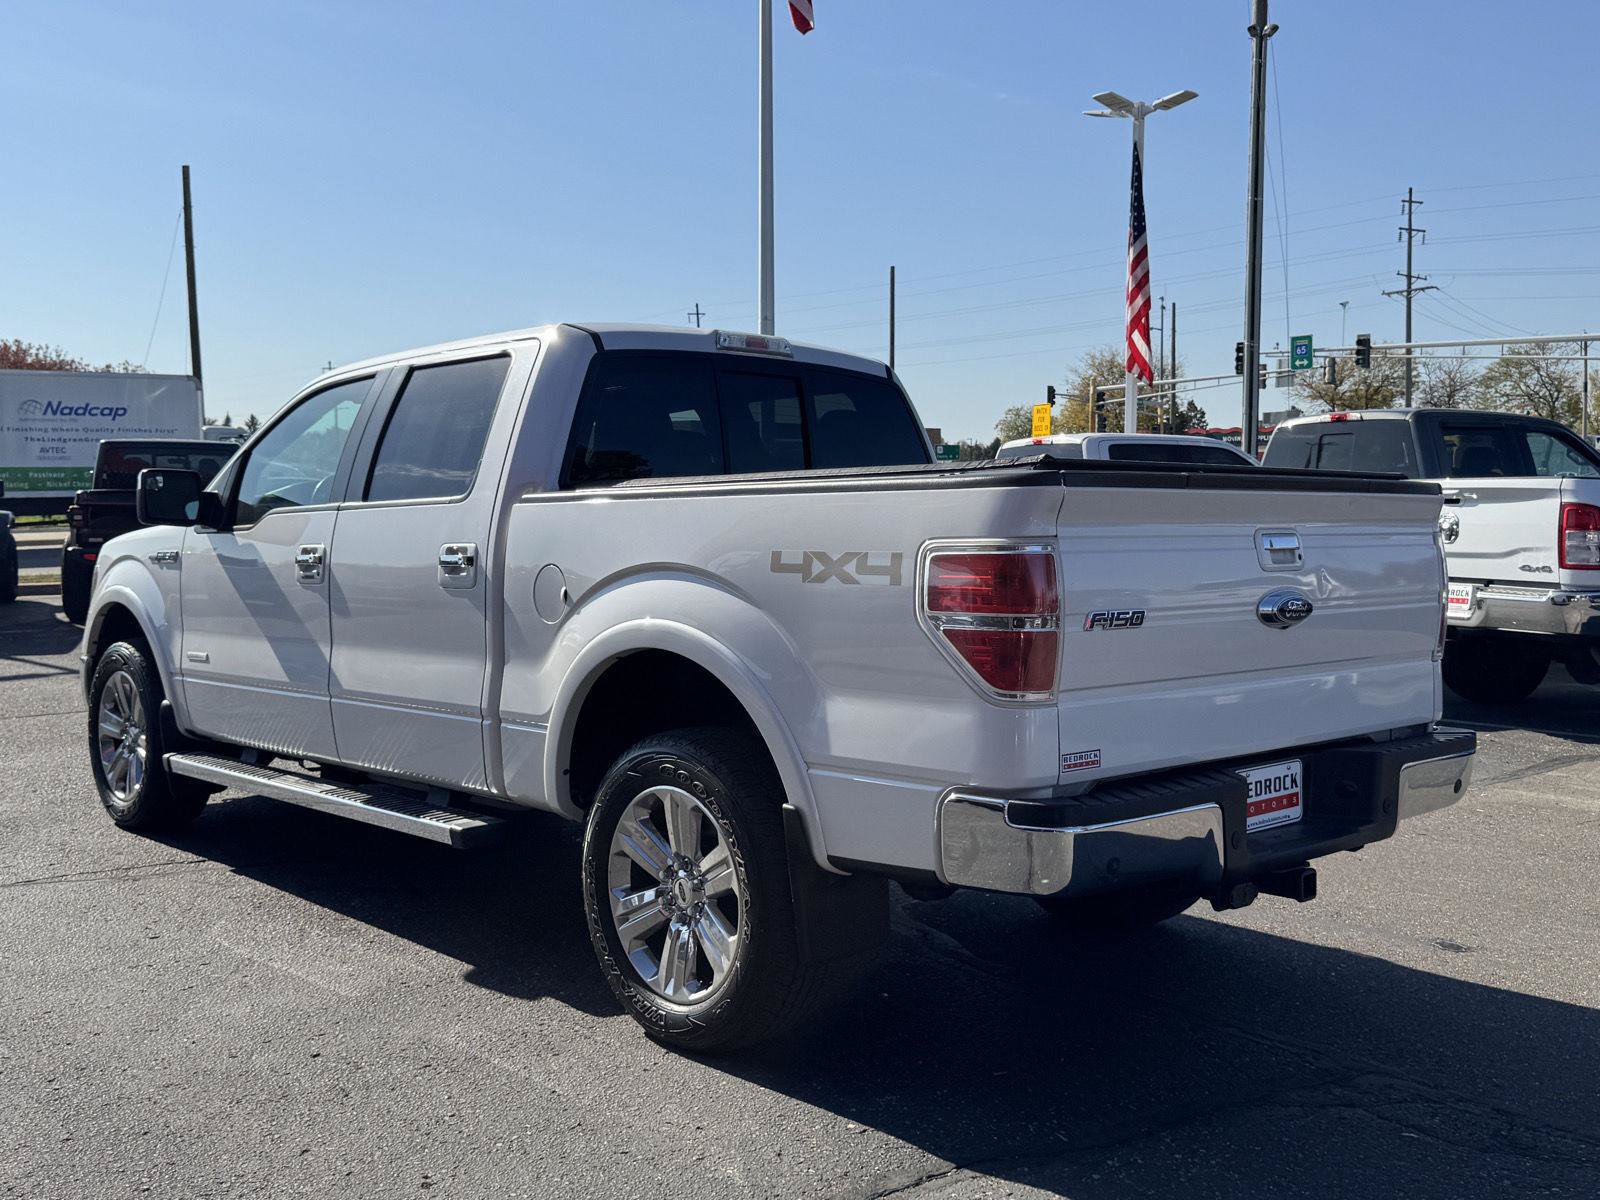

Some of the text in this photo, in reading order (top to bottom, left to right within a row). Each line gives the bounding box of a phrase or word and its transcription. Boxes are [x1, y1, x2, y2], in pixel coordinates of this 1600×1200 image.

[1296, 346, 1306, 355] 65
[42, 400, 128, 421] Nadcap
[39, 446, 67, 454] AVTEC
[1450, 589, 1470, 597] ROCK
[1063, 752, 1098, 763] BEDROCK
[1247, 772, 1299, 798] EDROCK
[1249, 796, 1297, 813] OTORS
